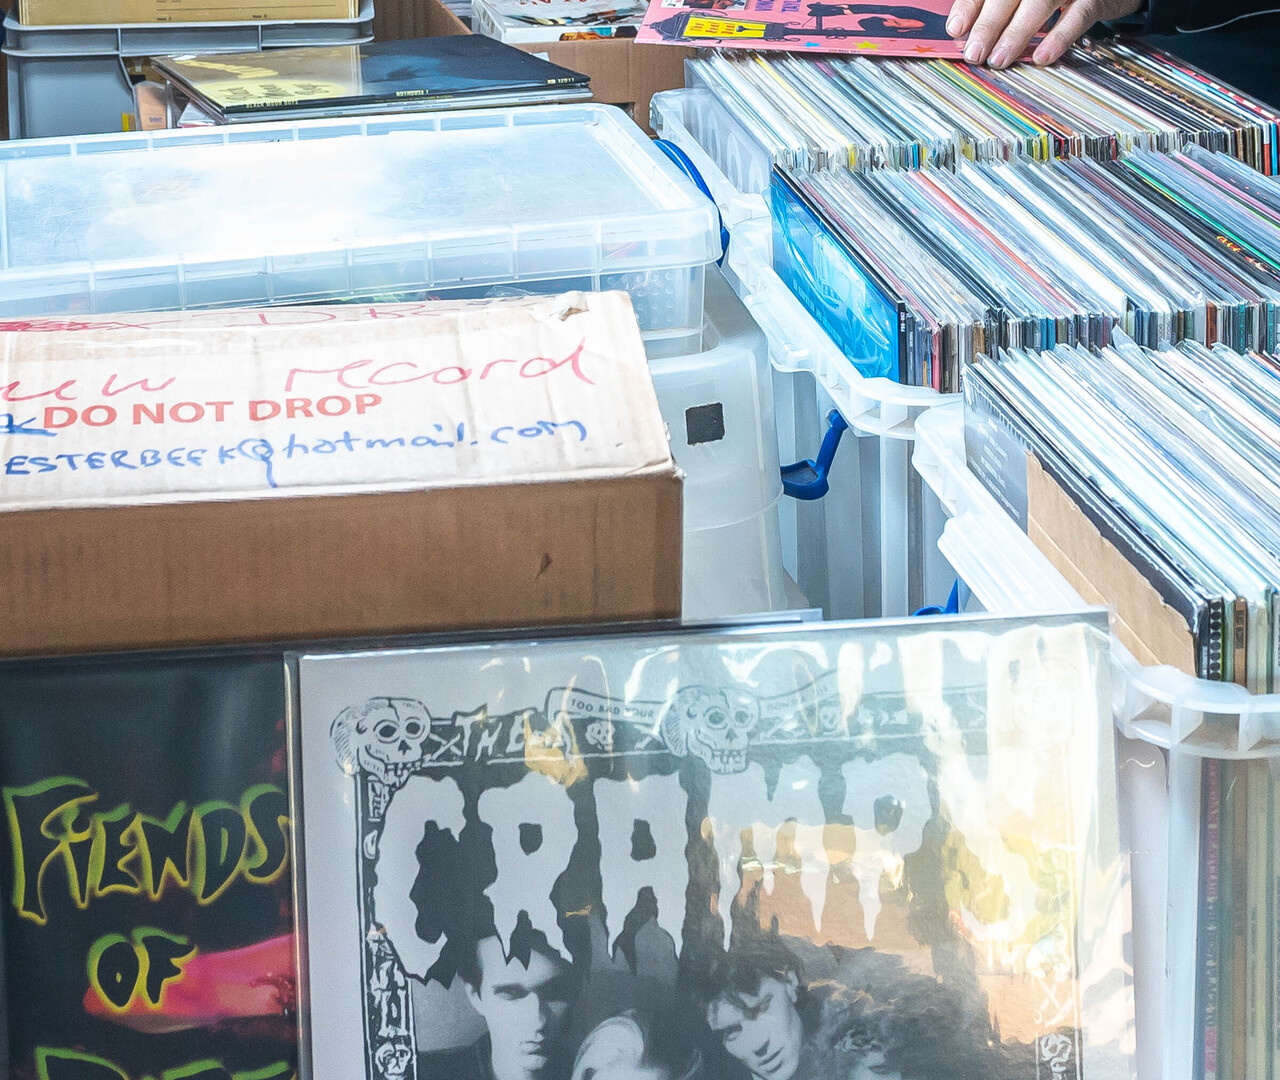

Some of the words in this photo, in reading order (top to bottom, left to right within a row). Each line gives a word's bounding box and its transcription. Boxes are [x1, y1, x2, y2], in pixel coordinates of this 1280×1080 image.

[284, 337, 596, 392] record
[43, 404, 112, 430] DO
[132, 400, 234, 426] NOT
[248, 392, 383, 422] DROP
[570, 698, 594, 714] TOO
[598, 703, 621, 716] BAD
[2, 776, 292, 926] FIENDS
[86, 926, 199, 1014] OF
